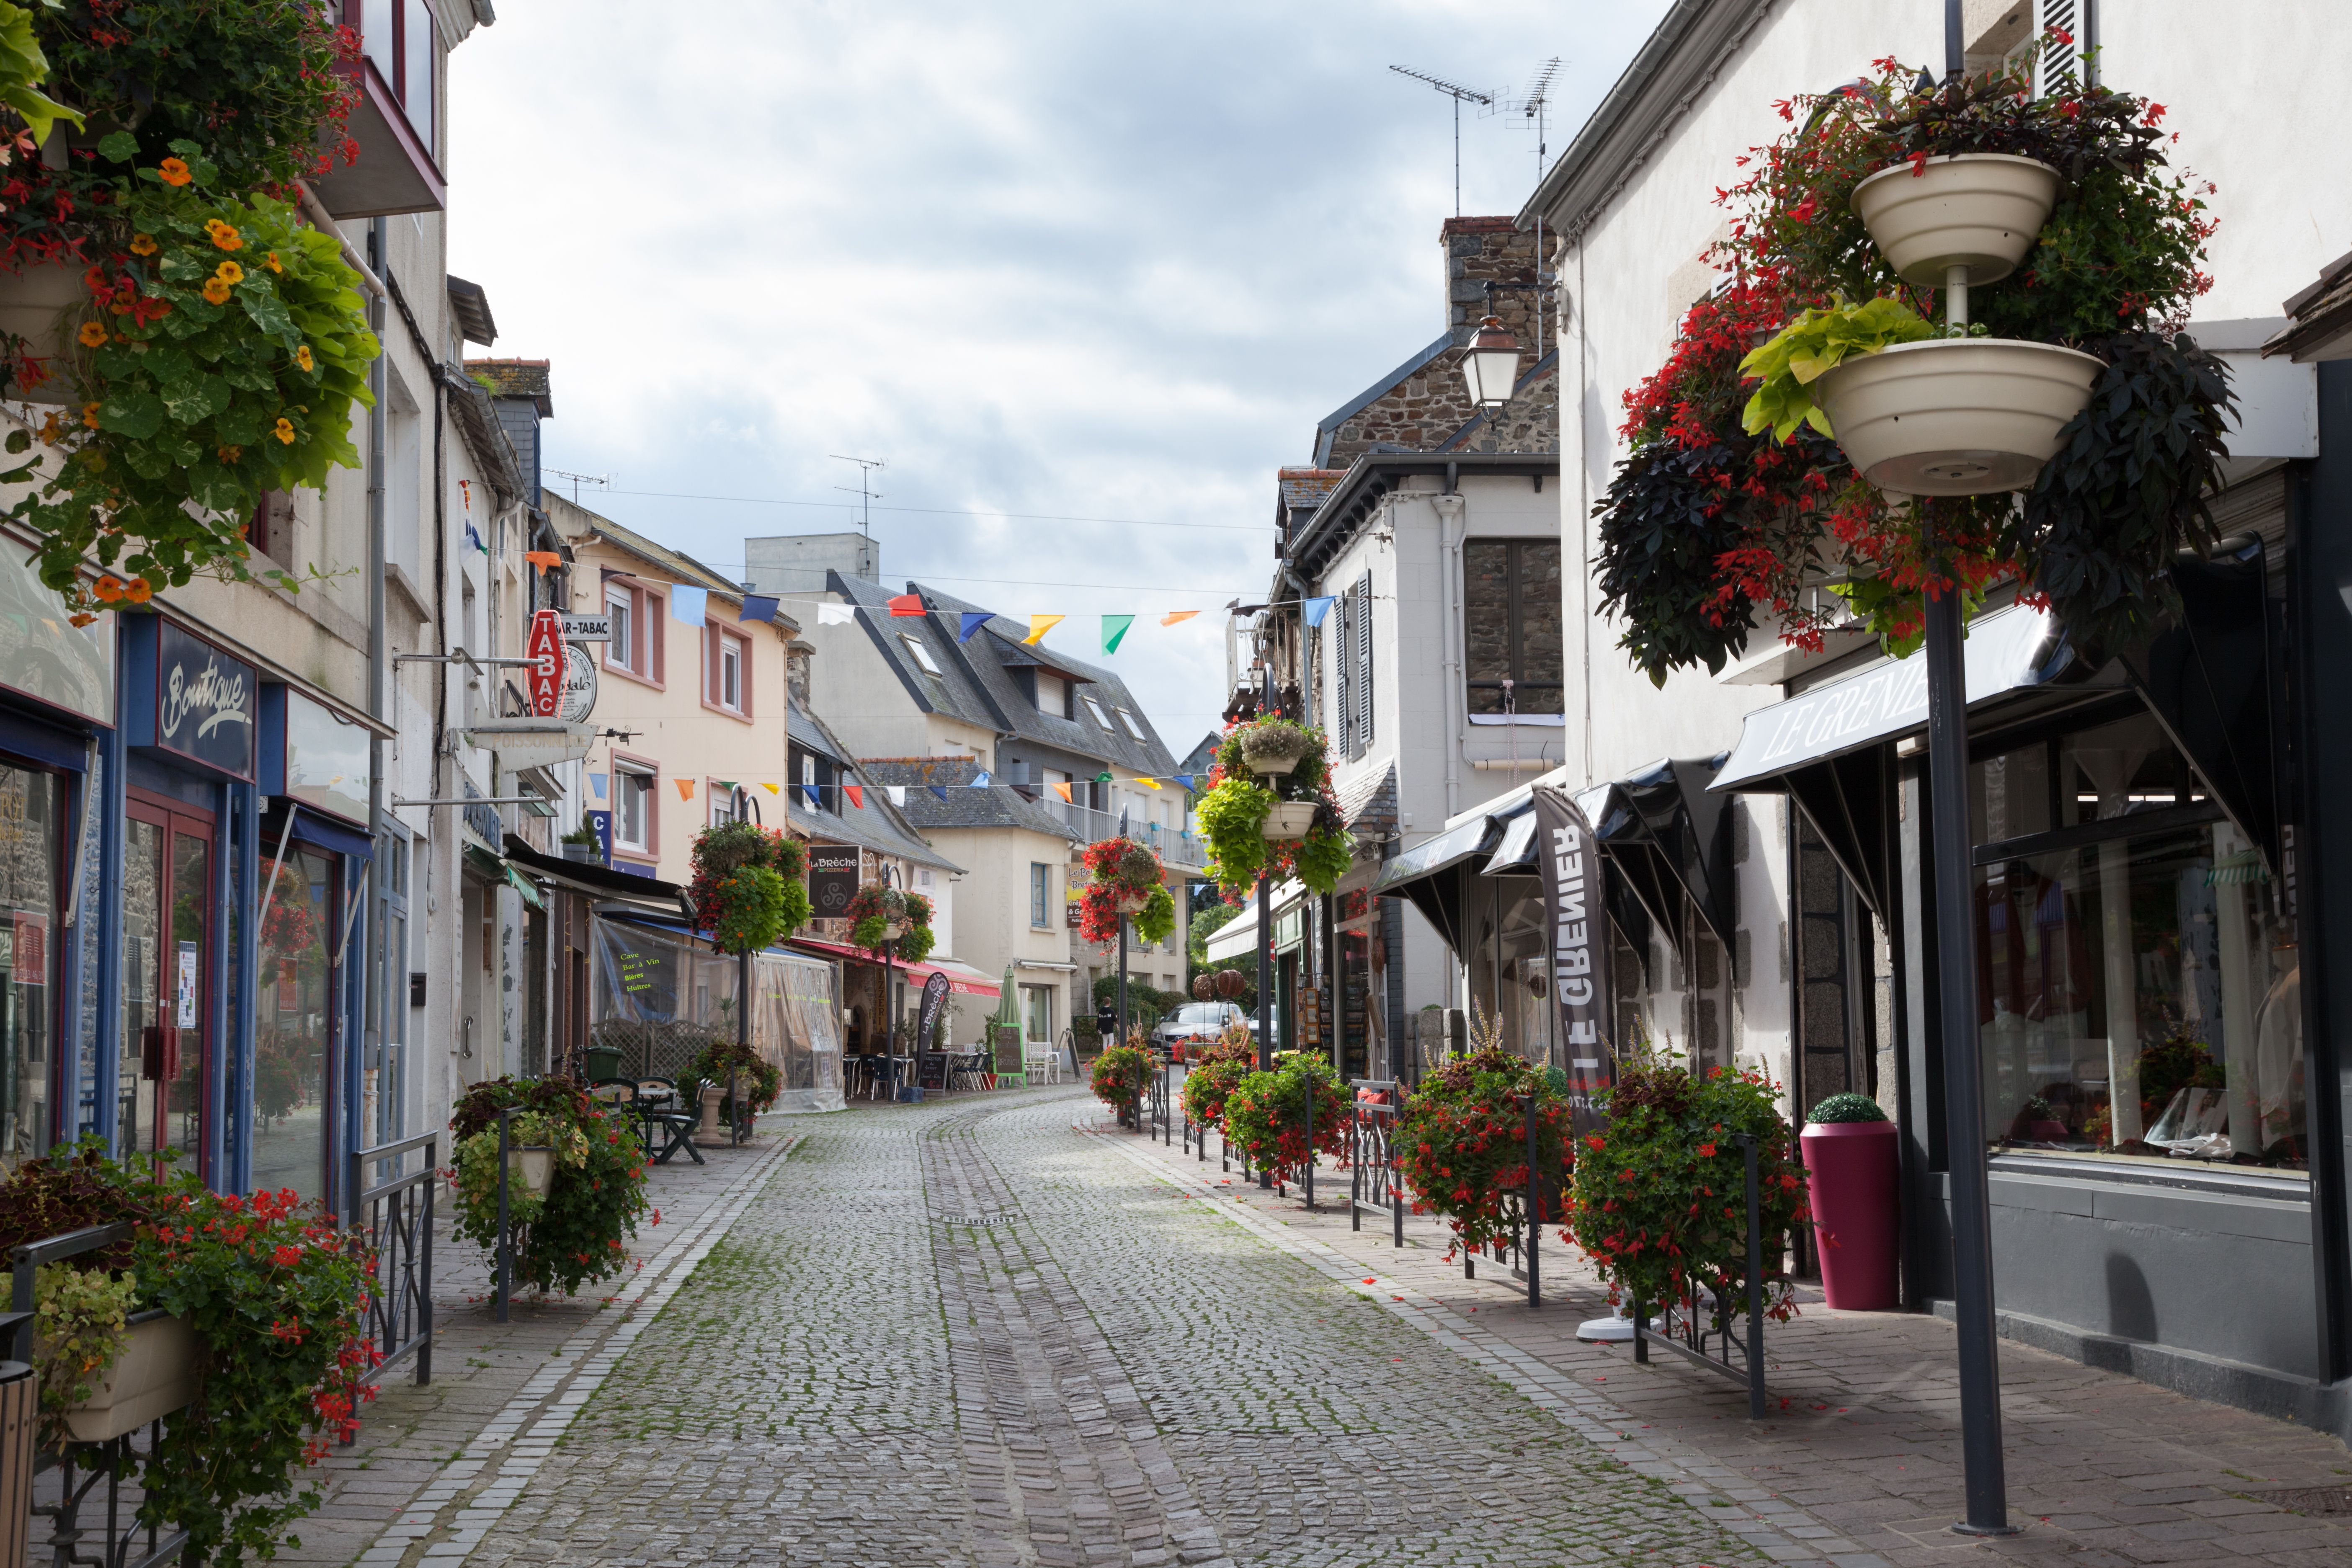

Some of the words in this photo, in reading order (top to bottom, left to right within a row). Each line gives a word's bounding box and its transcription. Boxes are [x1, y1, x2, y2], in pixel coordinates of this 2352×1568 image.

[538, 618, 555, 712] TABAC
[162, 655, 247, 740] Boutique
[1759, 702, 1816, 762] LE
[1804, 659, 1929, 748] GRENIE
[492, 734, 589, 748] POISSONNERIE
[1069, 868, 1078, 877] Le
[1071, 881, 1090, 889] Bret
[624, 973, 644, 981] Bières
[627, 983, 651, 992] Huîtres
[997, 1058, 1020, 1066] BRUNCH
